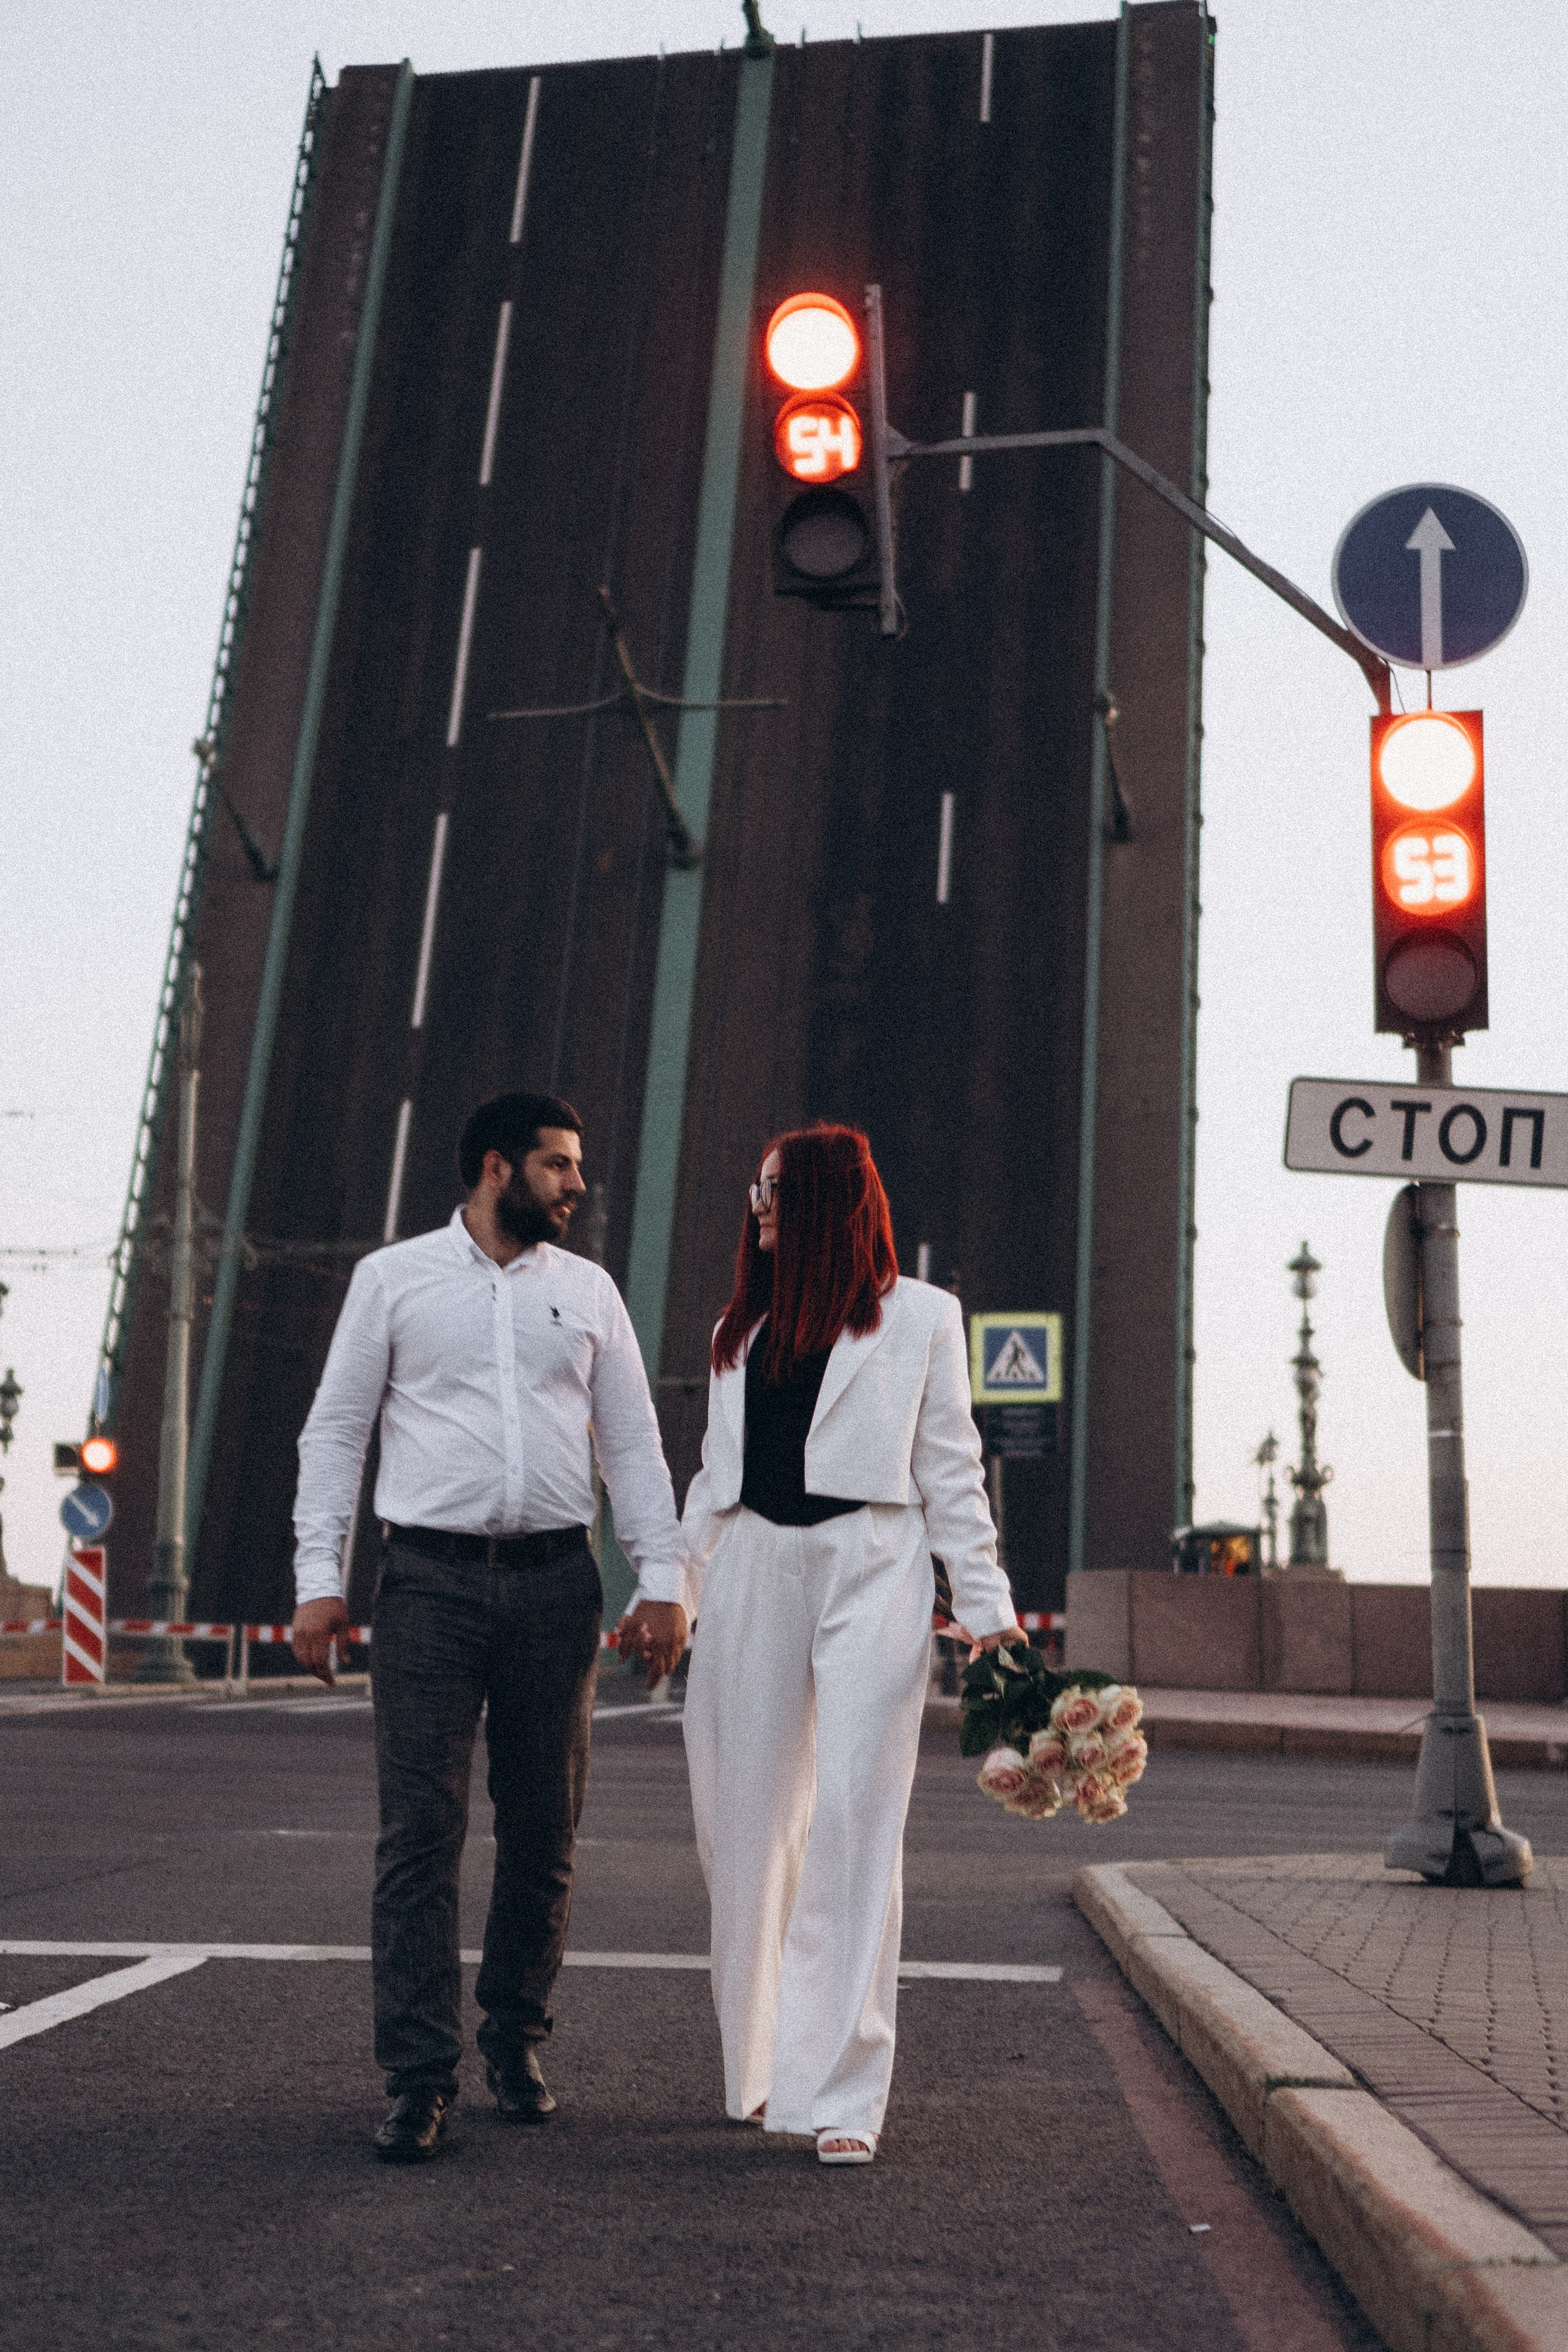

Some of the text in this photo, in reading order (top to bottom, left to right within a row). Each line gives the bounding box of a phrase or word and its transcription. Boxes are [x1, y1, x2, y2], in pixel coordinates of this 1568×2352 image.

[788, 416, 856, 474] 54
[1395, 834, 1469, 903] 53
[1330, 1097, 1545, 1168] СТОП
